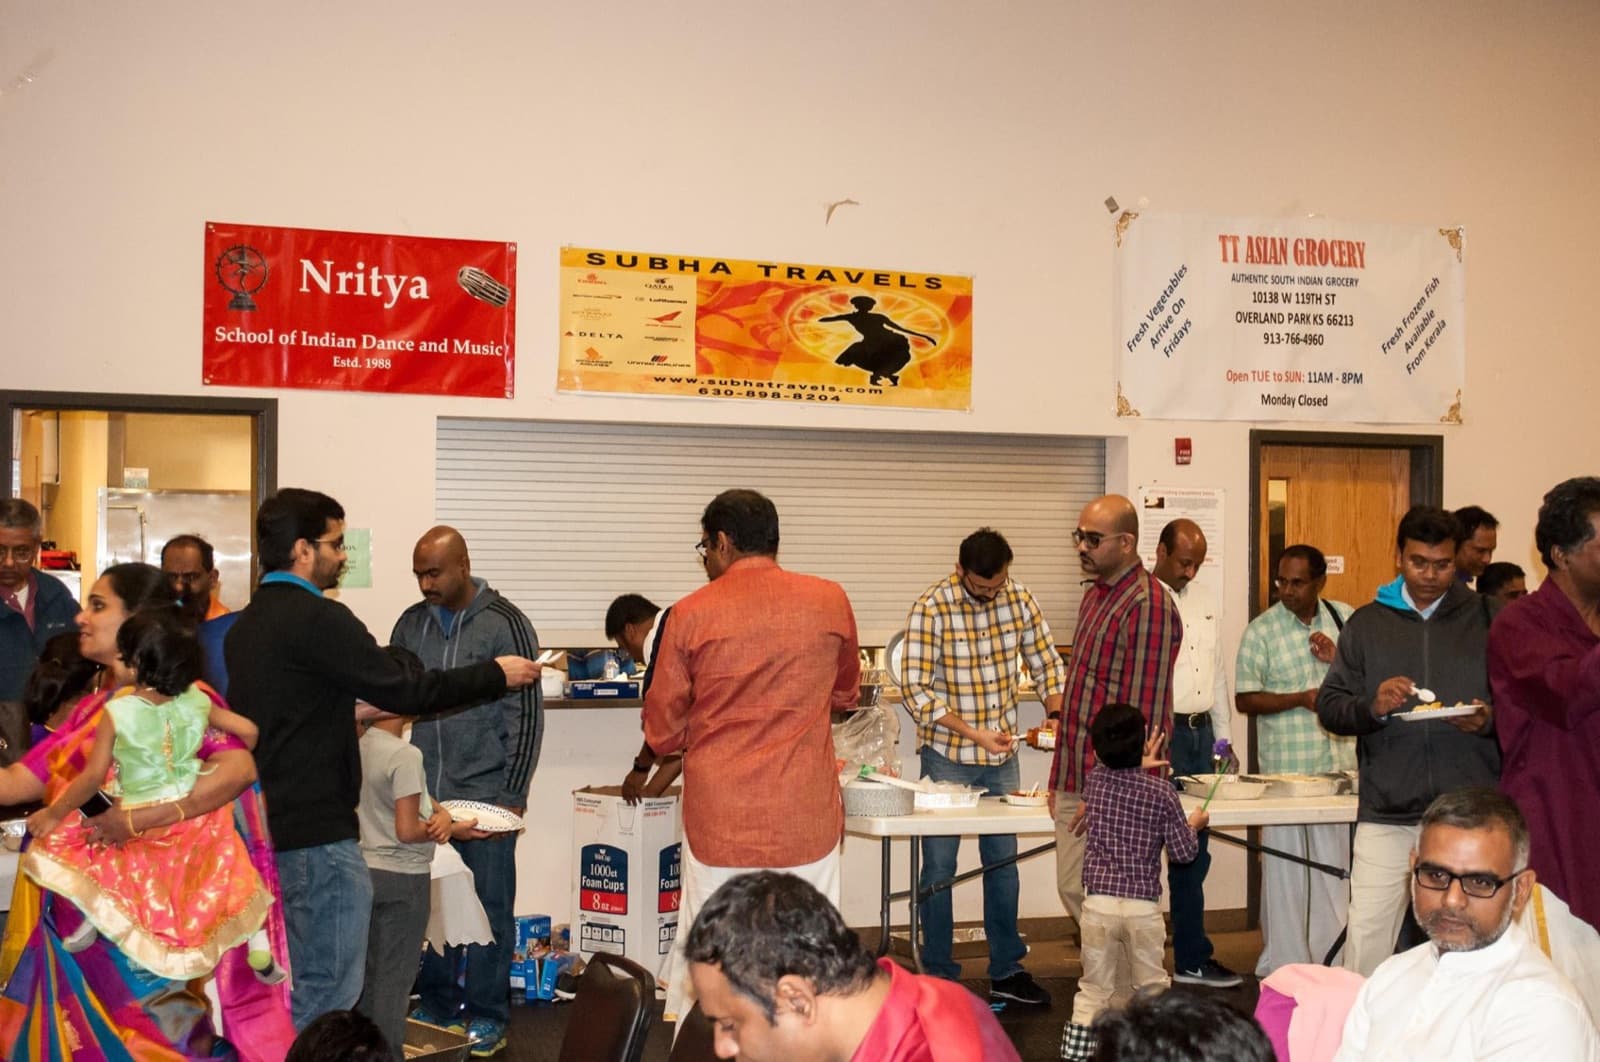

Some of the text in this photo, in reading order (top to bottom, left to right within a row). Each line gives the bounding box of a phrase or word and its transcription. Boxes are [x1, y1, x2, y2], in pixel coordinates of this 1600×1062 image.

[1218, 234, 1366, 269] TT ASIAN GROCERY
[586, 252, 942, 290] SUBHA TRAVELS
[1231, 273, 1359, 287] AUTHENTIC SOUTH INDIAN GROCERY
[299, 258, 429, 308] Nritya
[1252, 291, 1336, 306] 10138 W 119TH ST
[1126, 264, 1188, 352] Fresh Vegetables
[1381, 277, 1440, 354] Fresh Frozen Fish
[1150, 298, 1186, 350] Arrive On
[1235, 311, 1354, 327] OVERLAND PARK KS 66213
[579, 331, 623, 339] DELTA
[1163, 318, 1192, 358] Fridays
[1263, 332, 1324, 346] 913-766-4960
[1404, 309, 1435, 354] Available
[215, 326, 503, 357] School of Indian Dance and Music
[1406, 319, 1446, 375] From Kerala
[333, 356, 391, 370] Estd. 1988
[654, 376, 883, 394] www.subhatravels.com
[1226, 370, 1249, 384] Open
[1252, 370, 1270, 382] TUE
[1273, 371, 1283, 382] to
[1285, 371, 1305, 383] SUN:
[1307, 372, 1333, 384] 11AM
[1341, 372, 1363, 384] 8PM
[698, 388, 840, 402] 630-898-8204
[1261, 393, 1328, 408] Monday Closed
[590, 863, 617, 878] 1000ct
[582, 875, 624, 892] Foam Cups
[592, 892, 601, 910] 8
[671, 892, 678, 910] 8
